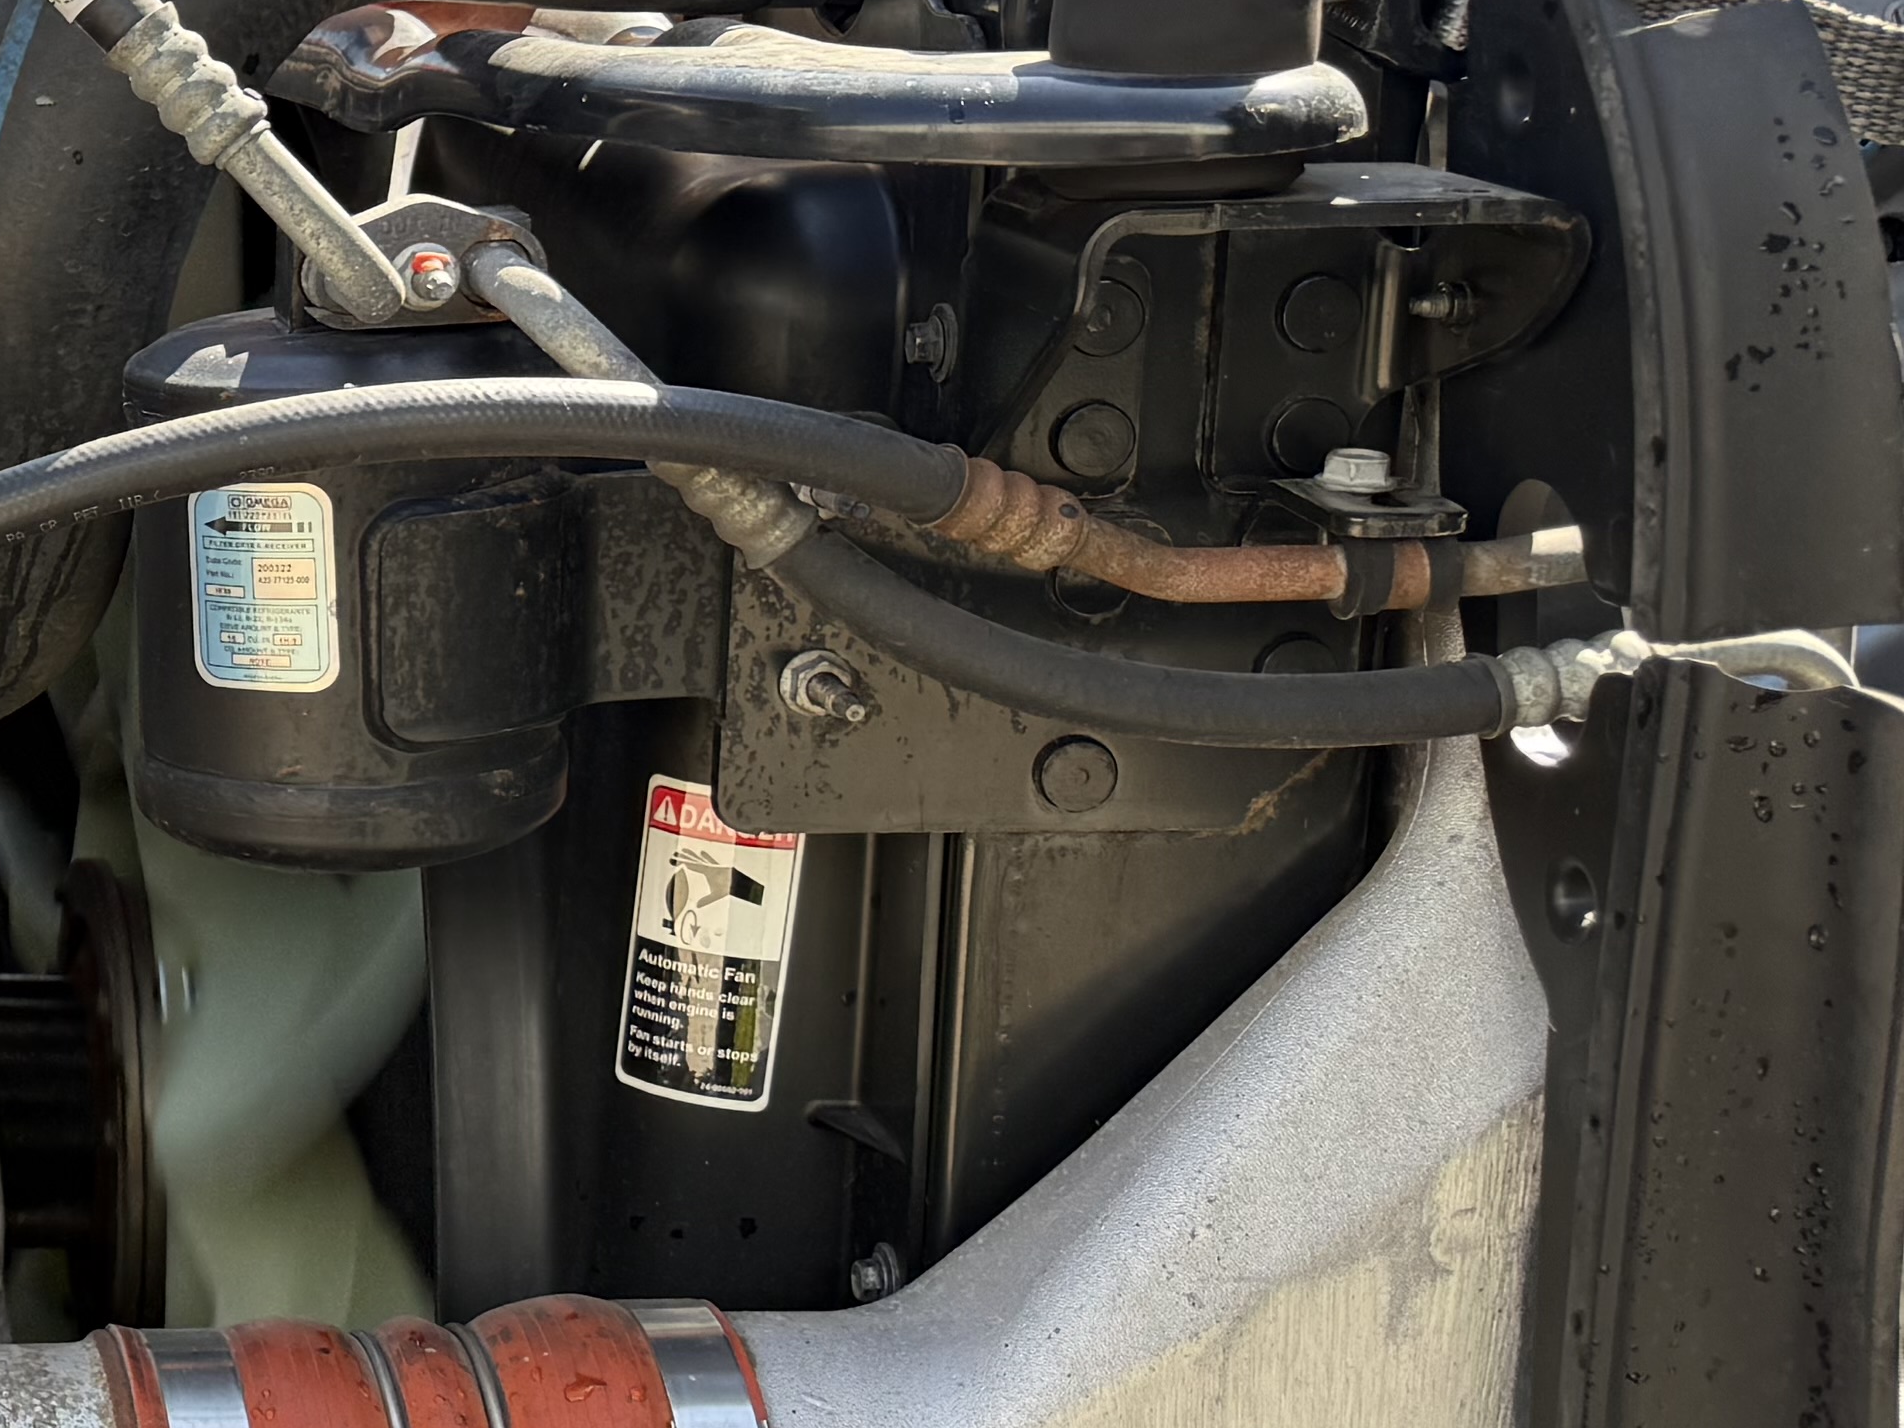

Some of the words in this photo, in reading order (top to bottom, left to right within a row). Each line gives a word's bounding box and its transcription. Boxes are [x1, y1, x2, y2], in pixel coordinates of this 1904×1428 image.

[246, 497, 289, 509] OMEGA
[638, 948, 720, 979] Automatic
[724, 967, 756, 984] Fan
[636, 971, 667, 992] Keep
[670, 982, 714, 1000] hands
[719, 992, 755, 1006] clear
[632, 1005, 684, 1030] running.
[634, 989, 665, 1007] when
[669, 1000, 718, 1019] engine
[722, 1008, 735, 1021] is
[628, 1040, 642, 1057] by
[644, 1045, 681, 1066] itself.
[630, 1024, 650, 1042] Fan
[653, 1035, 693, 1053] starts
[697, 1045, 714, 1056] or
[717, 1048, 758, 1063] stops
